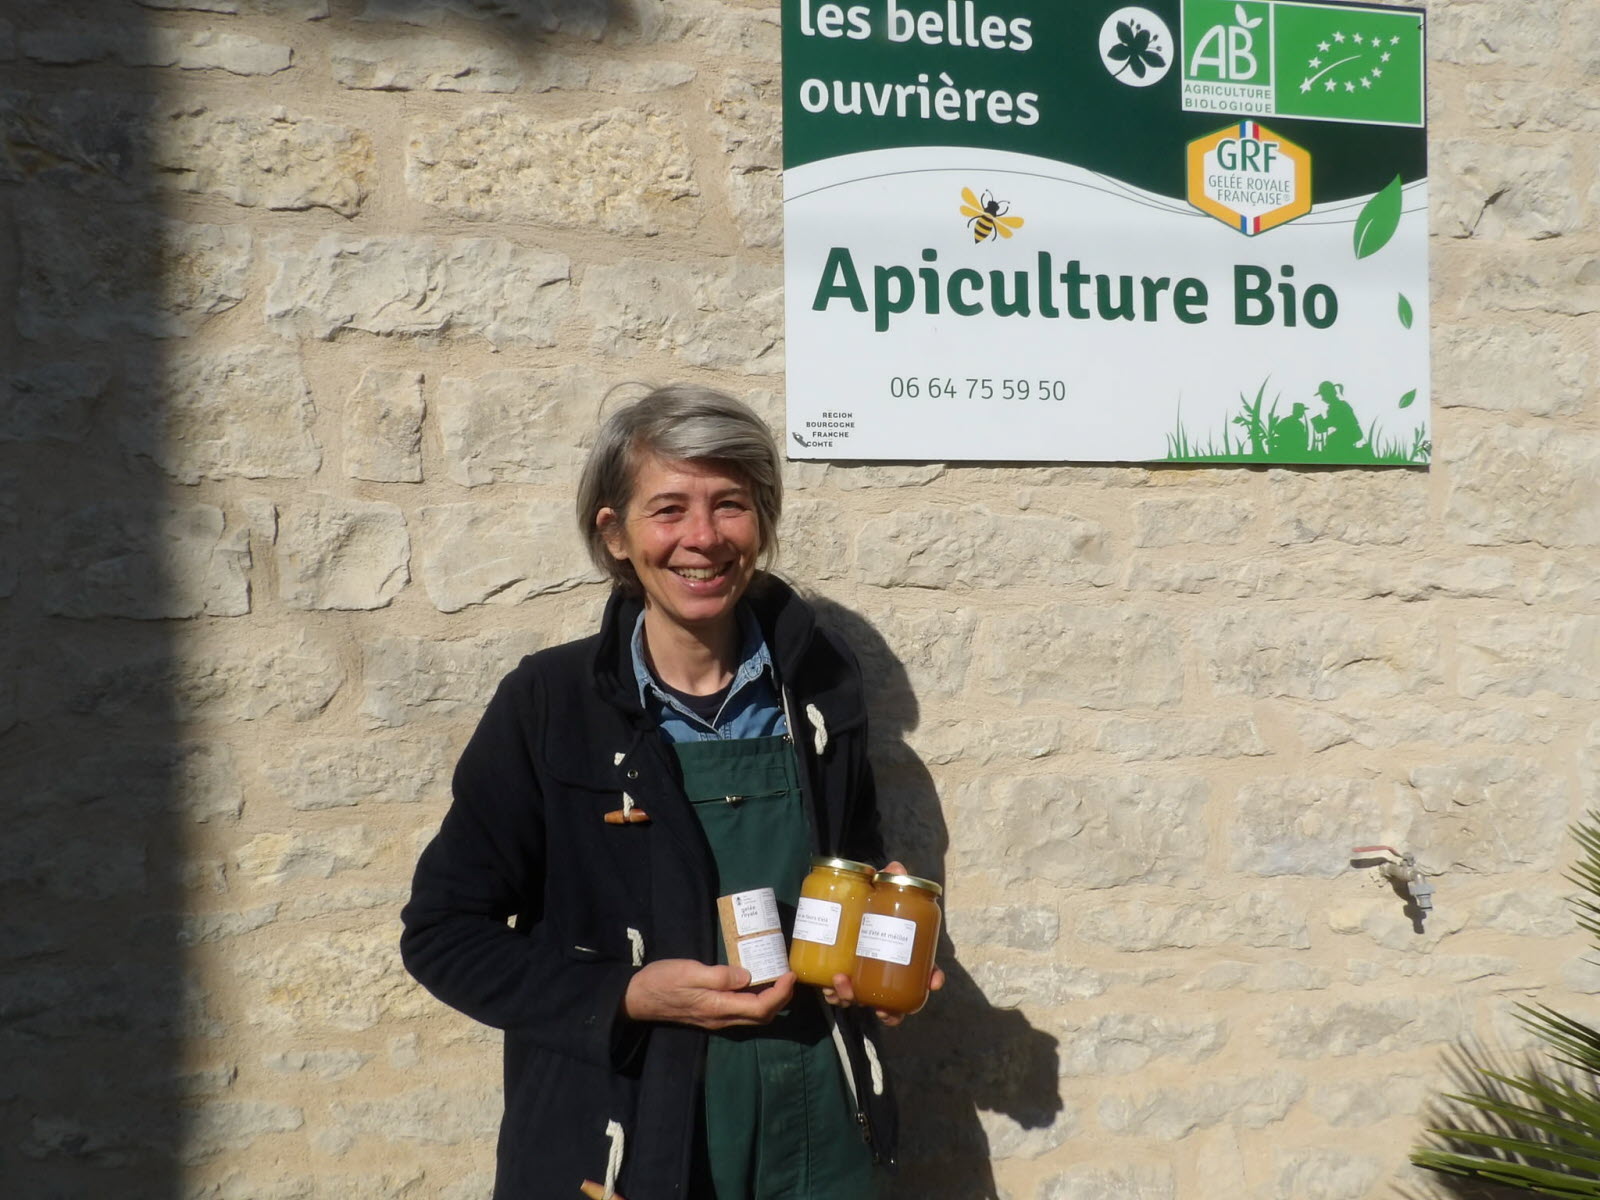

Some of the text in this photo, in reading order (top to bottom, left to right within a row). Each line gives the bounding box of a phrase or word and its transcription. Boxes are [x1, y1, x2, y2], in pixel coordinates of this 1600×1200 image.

[800, 0, 1033, 51] les belles
[1190, 25, 1258, 81] AB
[800, 72, 1040, 126] ouvrières
[1184, 84, 1272, 100] AGRICULTURE
[1185, 98, 1272, 113] BIOLOGIQUE
[1217, 139, 1278, 173] GRF
[1208, 174, 1290, 192] GELÉE ROYALE
[812, 247, 1338, 332] Apiculture Bio
[890, 377, 1066, 401] 06 64 75 59 50
